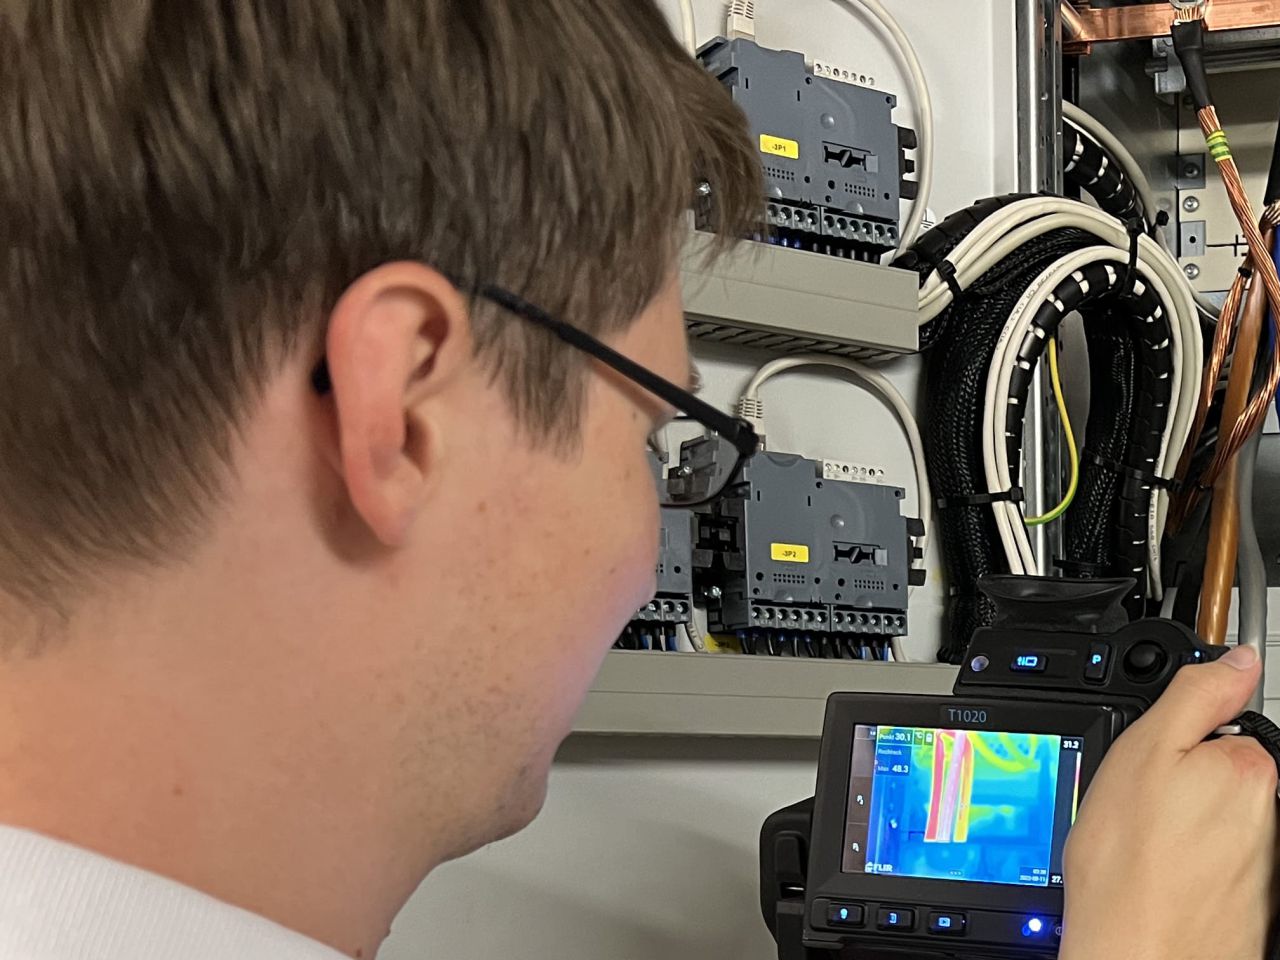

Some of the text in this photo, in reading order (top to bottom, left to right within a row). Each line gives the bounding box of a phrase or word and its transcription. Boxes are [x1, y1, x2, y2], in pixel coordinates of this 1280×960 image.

[948, 708, 987, 723] T1020
[895, 732, 911, 742] 30.1
[892, 764, 909, 773] 48.3
[1051, 875, 1063, 884] 27.
